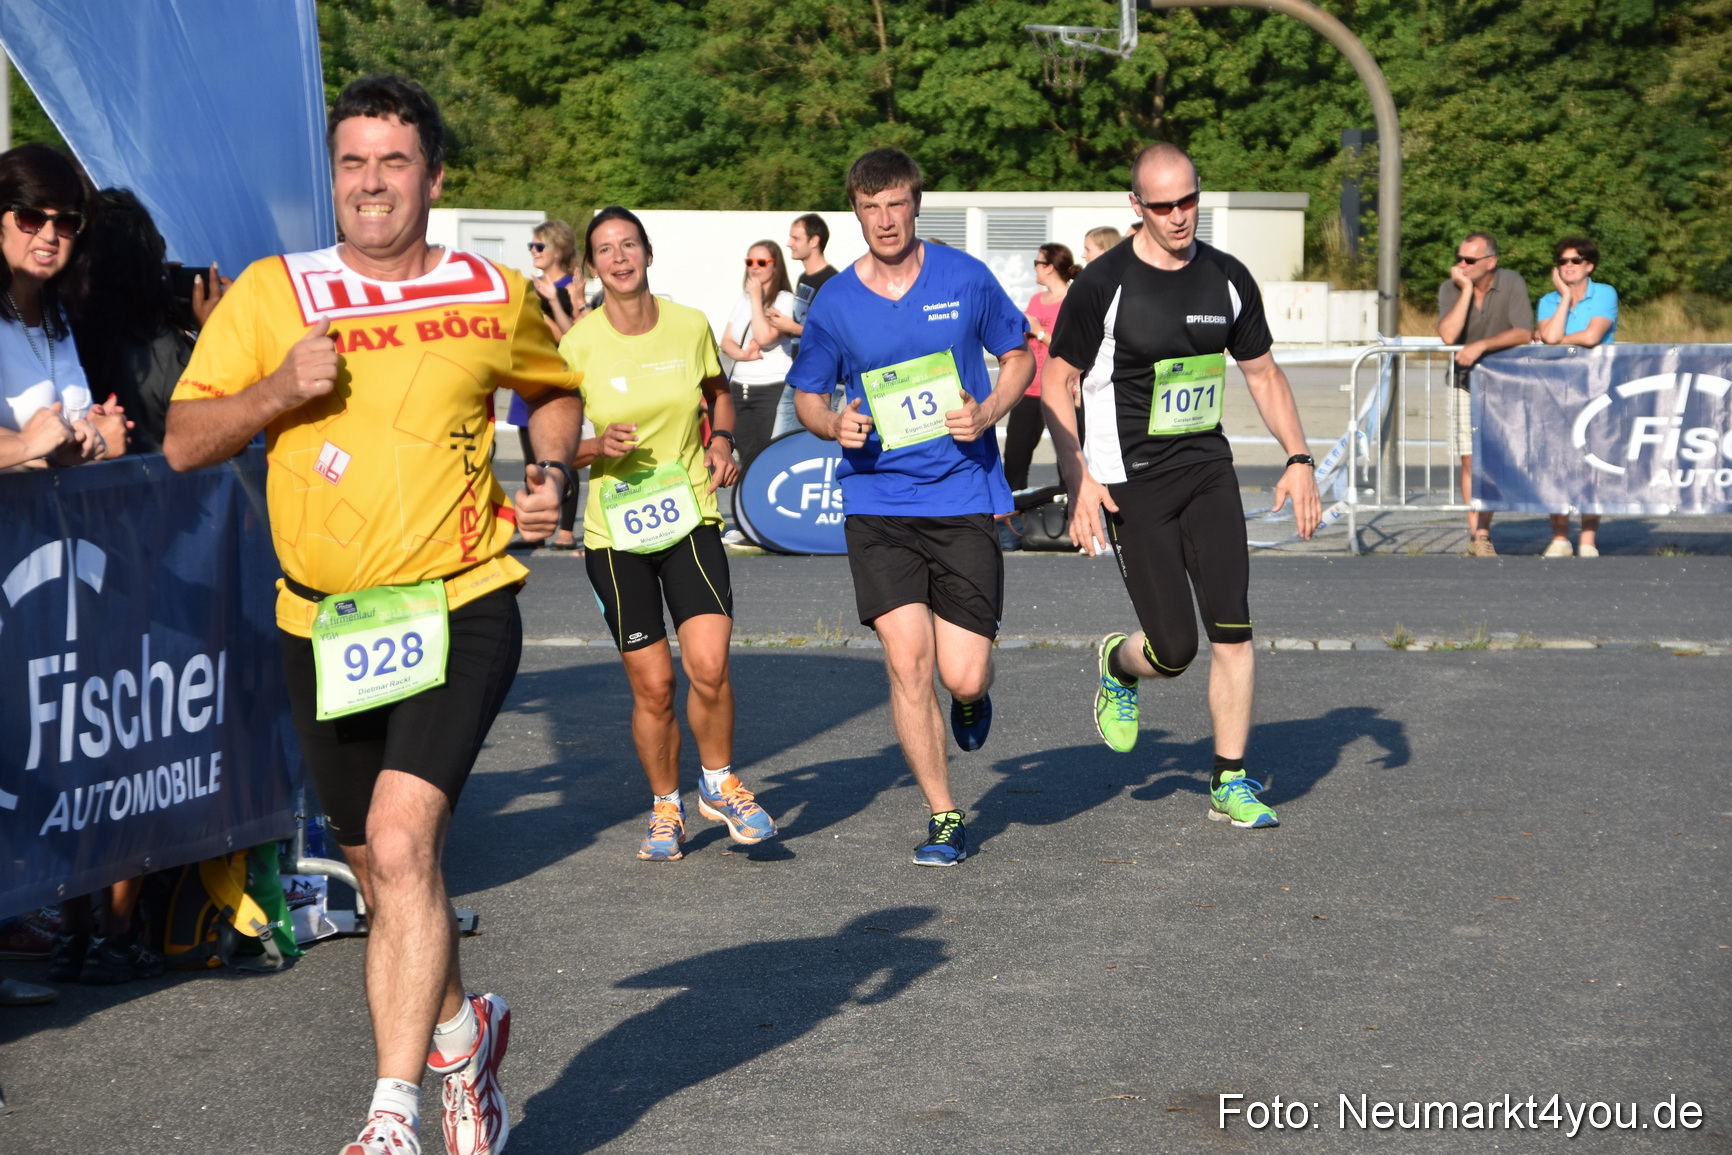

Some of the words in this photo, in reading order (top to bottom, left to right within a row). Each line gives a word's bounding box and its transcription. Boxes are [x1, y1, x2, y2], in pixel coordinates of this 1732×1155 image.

[923, 302, 947, 312] Christian
[947, 300, 960, 308] Lenz
[927, 313, 951, 321] Allianz
[415, 311, 507, 342] BÖGL
[900, 390, 938, 421] 13
[1161, 384, 1216, 413] 1071
[1626, 416, 1732, 462] Fis
[624, 498, 680, 534] 638
[815, 512, 847, 525] AU
[330, 608, 376, 625] firmenlauf
[343, 631, 424, 682] 928
[358, 683, 389, 696] Dietmar
[389, 676, 411, 689] Rackl
[39, 751, 222, 836] AUTOMOBILE
